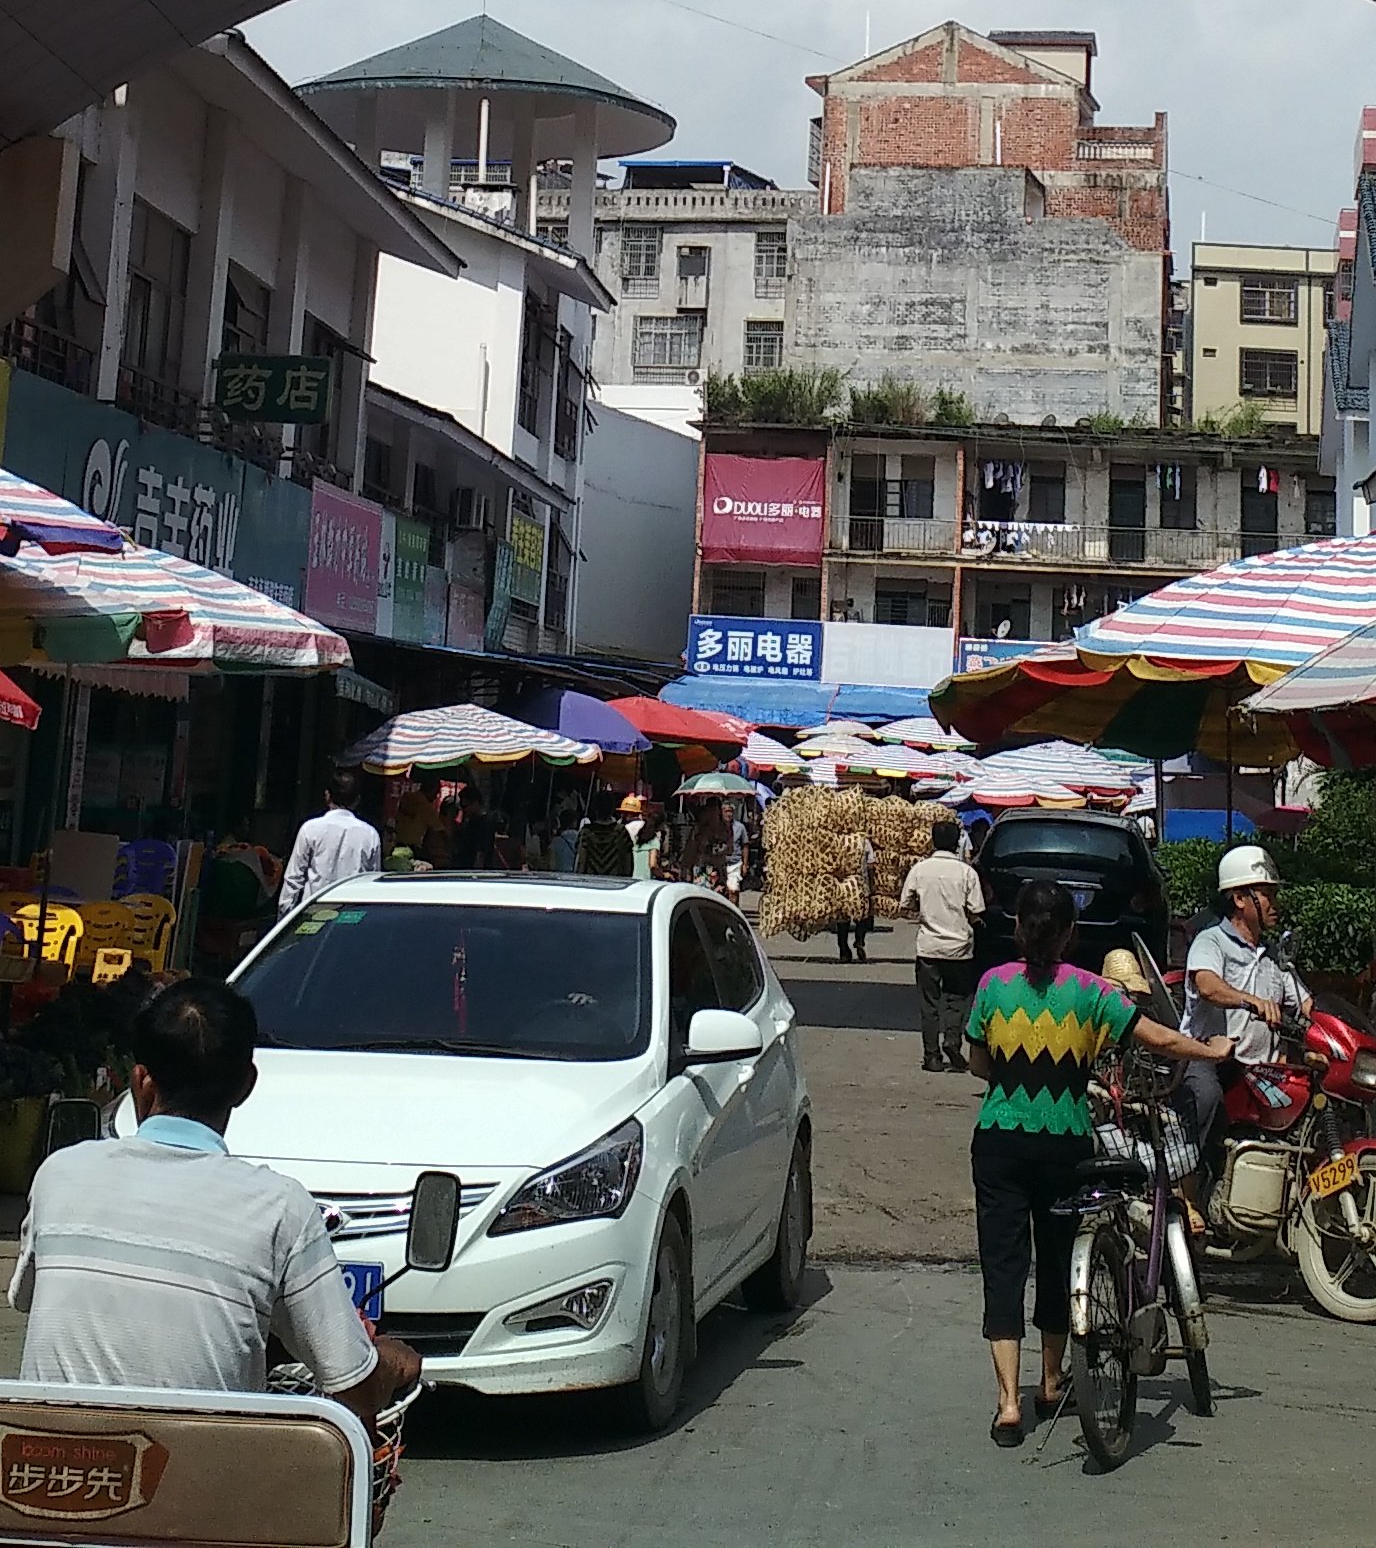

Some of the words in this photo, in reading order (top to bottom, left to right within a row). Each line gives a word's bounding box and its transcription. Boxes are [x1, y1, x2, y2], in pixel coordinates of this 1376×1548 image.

[224, 363, 328, 411] 药店
[696, 628, 813, 665] 多丽电器
[1312, 1158, 1355, 1193] V5299
[7, 1462, 123, 1502] 步步先
